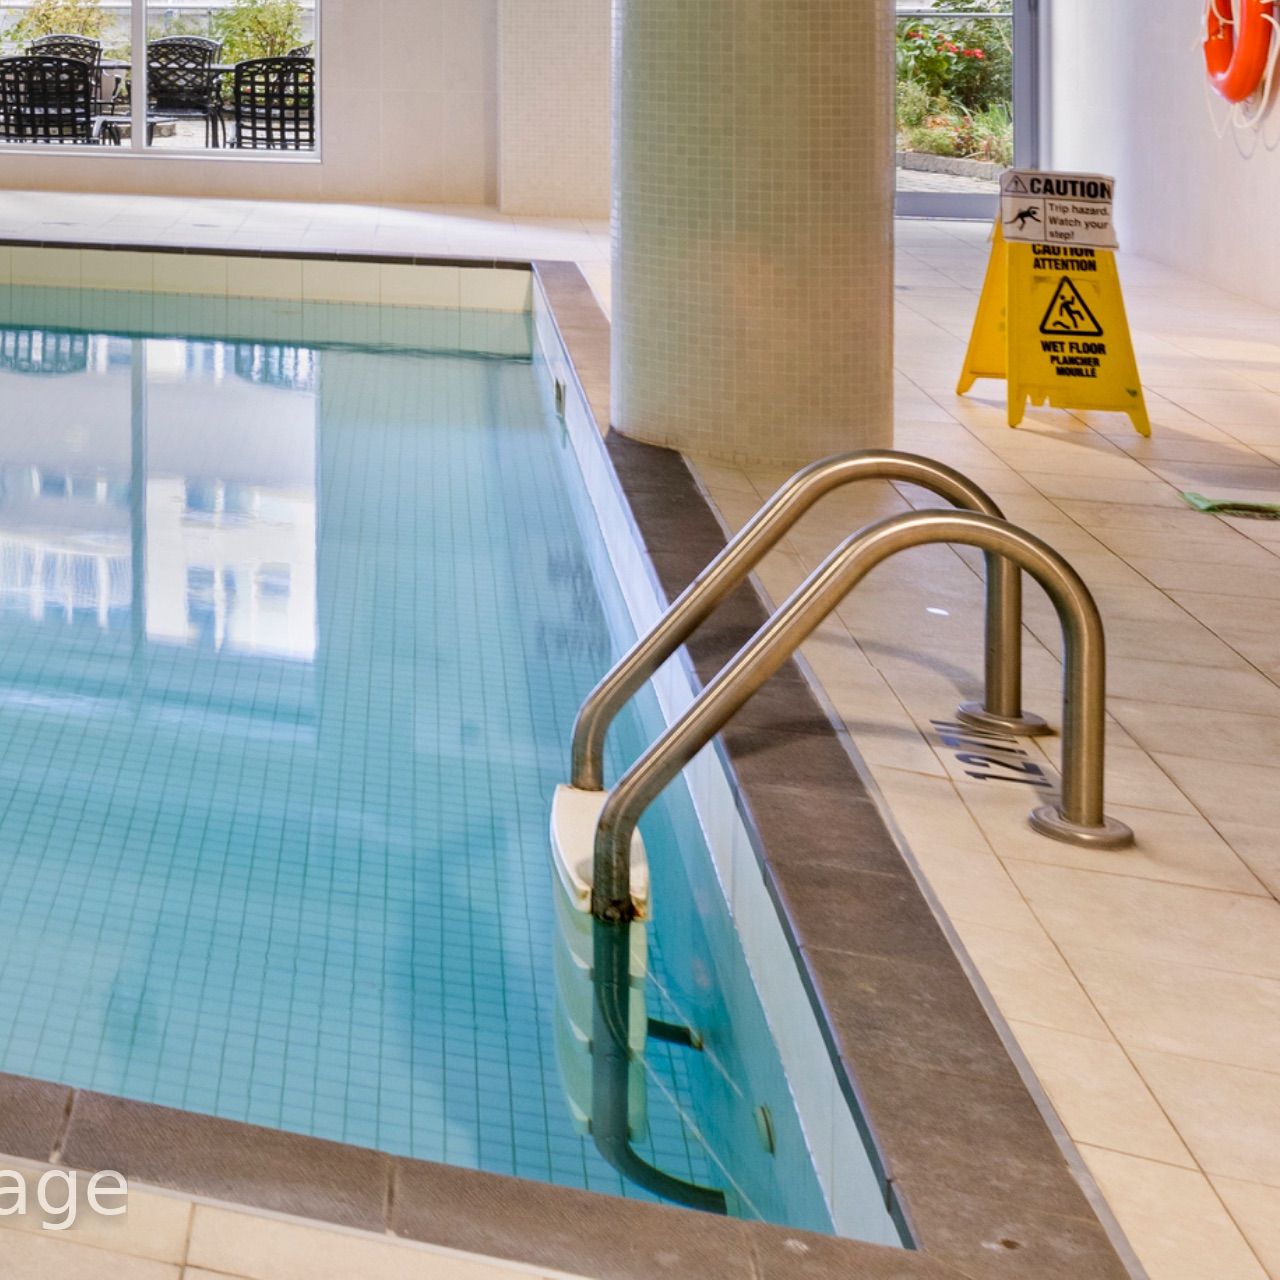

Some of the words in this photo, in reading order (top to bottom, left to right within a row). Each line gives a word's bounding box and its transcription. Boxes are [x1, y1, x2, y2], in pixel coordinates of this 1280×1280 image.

[1030, 177, 1112, 200] CAUTION
[1048, 202, 1069, 214] Trip
[1071, 204, 1109, 216] hazard.
[1048, 216, 1081, 228] Watch
[1084, 220, 1109, 230] your
[1049, 230, 1075, 240] step!
[1032, 244, 1095, 257] CAUTION
[1033, 257, 1097, 272] ATTENTION
[1040, 340, 1065, 353] WET
[1068, 341, 1107, 355] FLOOR
[1050, 354, 1101, 367] PLANCHER
